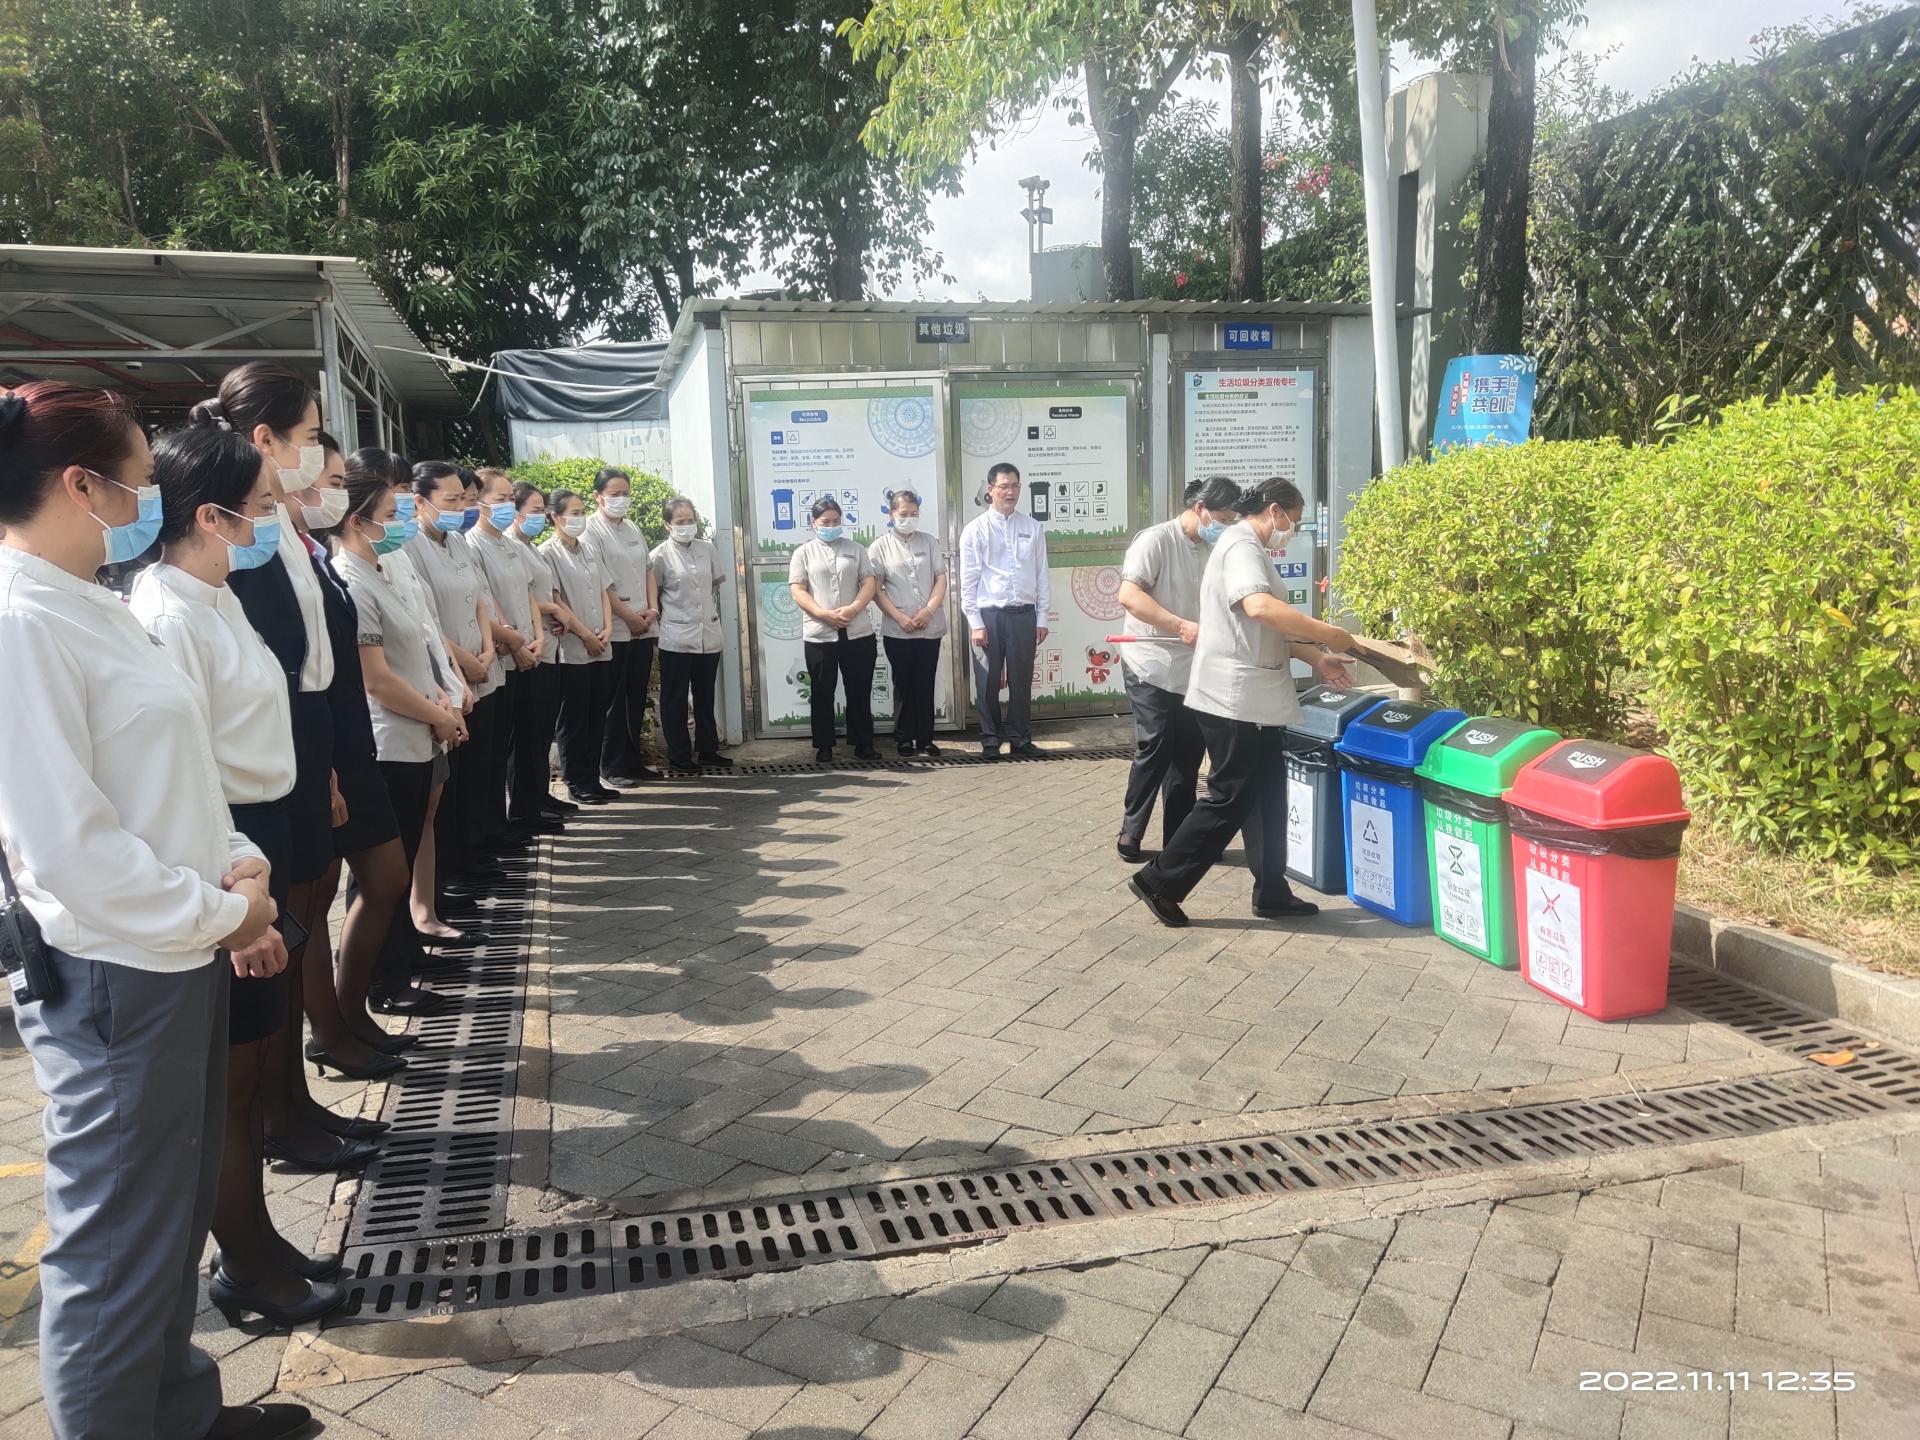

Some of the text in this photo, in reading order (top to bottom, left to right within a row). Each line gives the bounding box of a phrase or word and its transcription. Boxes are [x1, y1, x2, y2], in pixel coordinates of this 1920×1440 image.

[919, 322, 965, 336] 其他垃圾
[1228, 329, 1271, 342] 可回收物
[1218, 377, 1297, 387] 生活垃圾分类宣传专栏
[1474, 376, 1509, 393] 携手
[1472, 396, 1507, 413] 共创
[1319, 691, 1346, 702] PUSH
[1385, 710, 1411, 722] PUSH
[1468, 729, 1498, 743] PUSH
[1568, 751, 1606, 768] PUSH
[1355, 781, 1385, 797] 垃圾分类
[1356, 794, 1386, 808] 从我做起
[1436, 807, 1472, 828] 垃圾分类
[1437, 820, 1472, 842] 从我做起
[1529, 844, 1570, 868] 垃圾分类
[1529, 857, 1570, 884] 从我做起
[1540, 926, 1566, 944] 有害垃圾
